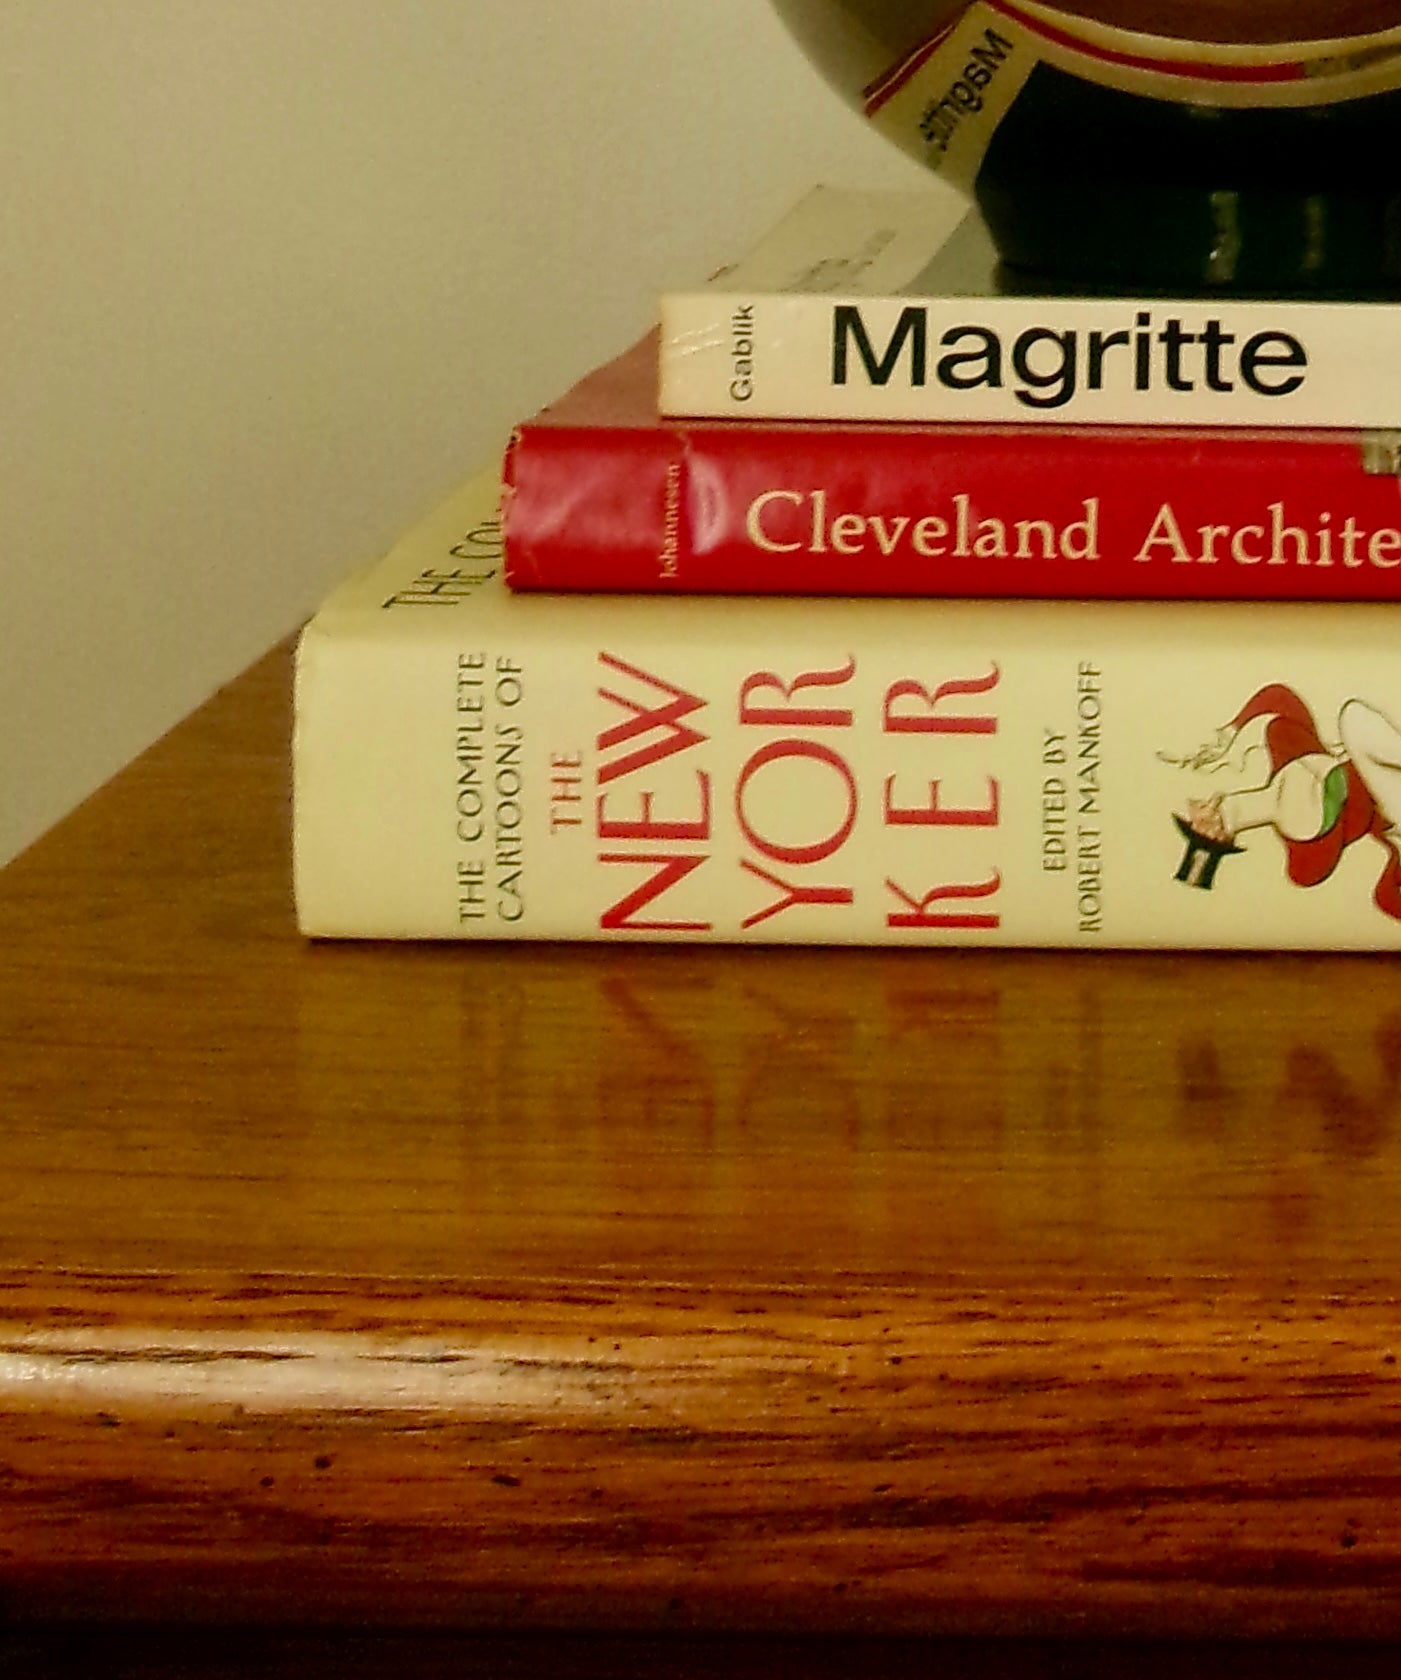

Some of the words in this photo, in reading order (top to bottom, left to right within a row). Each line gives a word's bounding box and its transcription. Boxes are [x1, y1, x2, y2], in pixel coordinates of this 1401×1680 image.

[730, 304, 756, 402] Gablik
[829, 305, 1308, 409] Magritte
[744, 489, 1102, 561] Cleveland
[382, 569, 496, 609] THE
[494, 656, 523, 707] OF
[456, 652, 486, 842] COMPLETE
[1043, 728, 1067, 770] BY
[1077, 661, 1103, 815] MANKOFF
[494, 723, 525, 922] CARTOONS
[549, 751, 582, 836] THE
[596, 651, 713, 931] NEW
[735, 654, 857, 930] YOR
[883, 659, 1002, 929] KER
[1042, 778, 1068, 872] EDITED
[458, 860, 487, 923] THE
[1078, 826, 1103, 934] ROBERT
